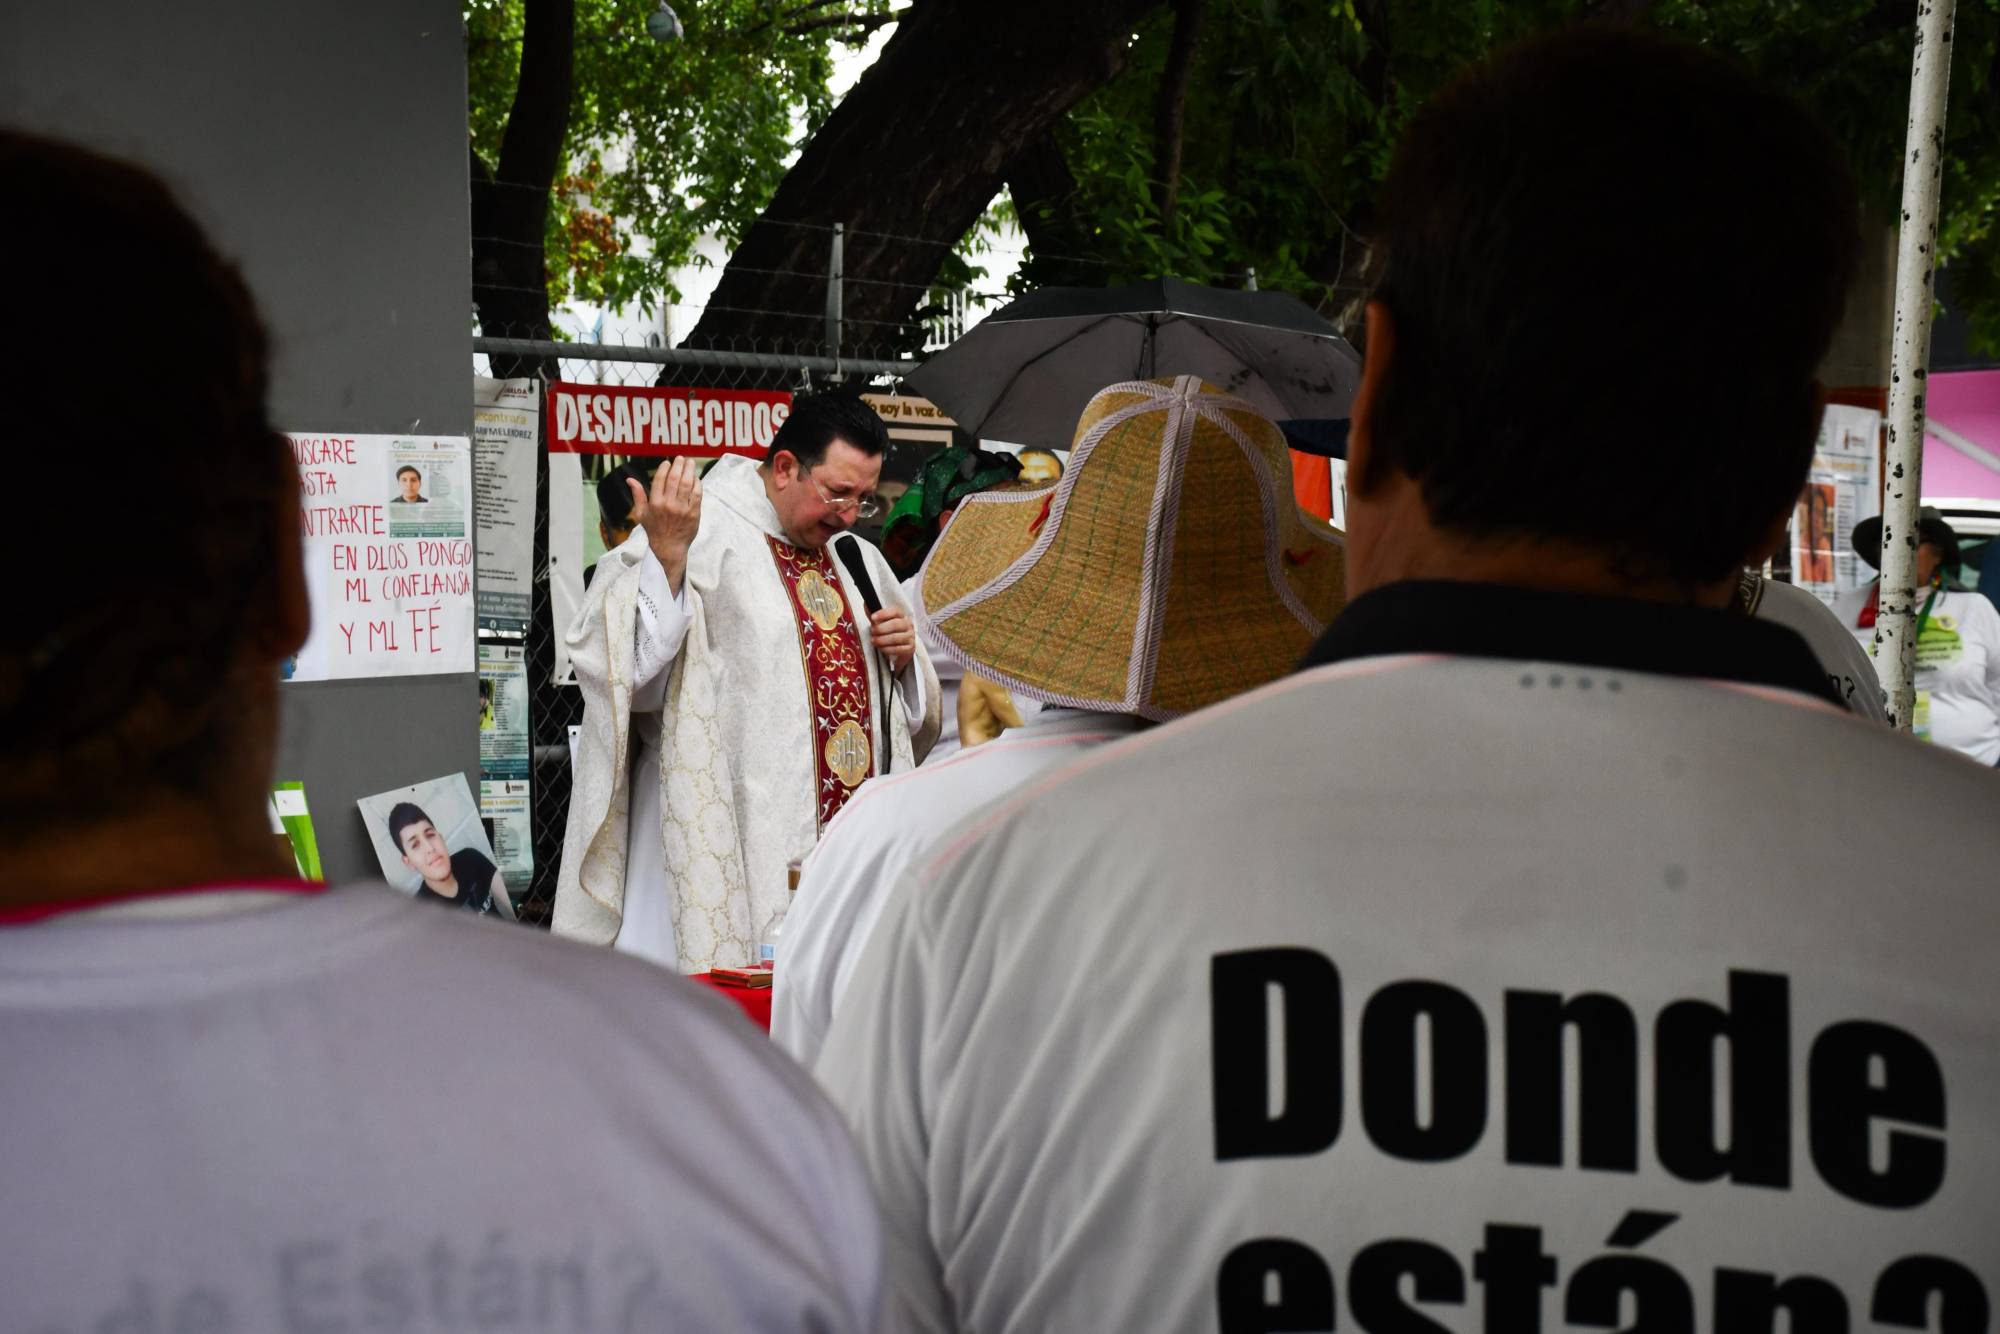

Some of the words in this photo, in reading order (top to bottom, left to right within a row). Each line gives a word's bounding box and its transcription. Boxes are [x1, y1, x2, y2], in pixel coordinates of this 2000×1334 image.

[556, 392, 790, 448] DESAPARECIDOS
[880, 404, 900, 418] soy
[903, 402, 912, 416] la
[915, 406, 934, 417] voz
[333, 544, 357, 571] EN
[417, 540, 472, 568] PONGO
[345, 578, 372, 602] MI
[382, 570, 471, 601] CONFIANSA
[339, 622, 355, 655] Y
[369, 620, 398, 652] MI
[1210, 945, 1948, 1210] Donde
